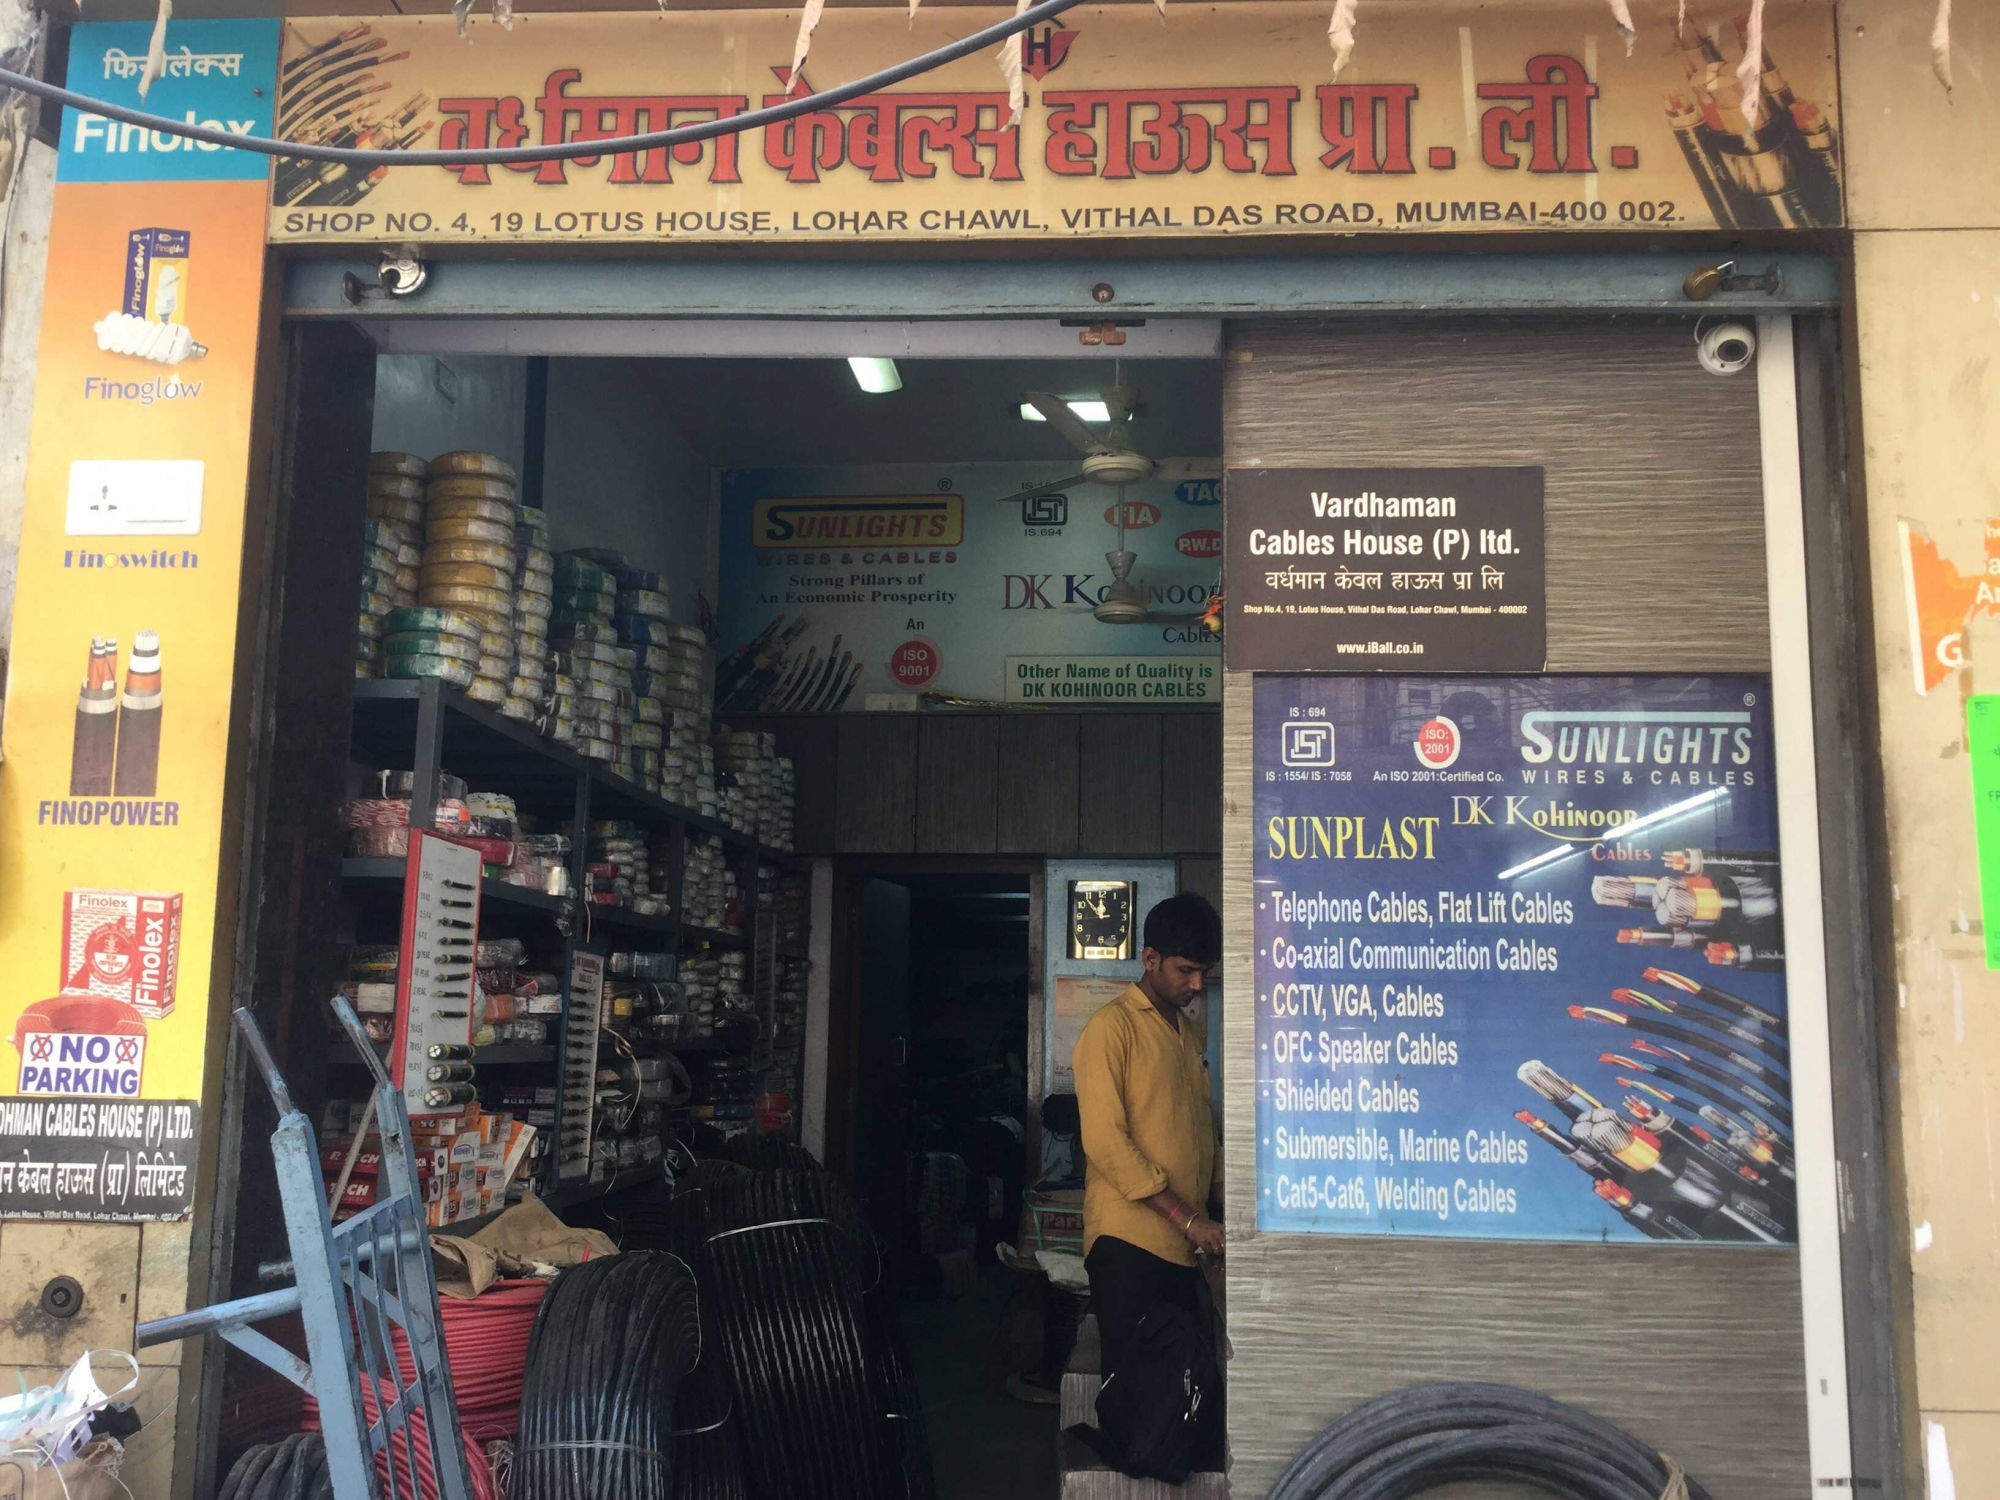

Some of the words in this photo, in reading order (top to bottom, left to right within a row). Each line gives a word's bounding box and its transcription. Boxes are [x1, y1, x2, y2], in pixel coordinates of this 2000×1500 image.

[75, 111, 255, 153] Finolex
[285, 213, 378, 232] SHOP
[386, 213, 440, 232] NO.
[452, 213, 478, 236] 4,
[491, 212, 522, 231] 19
[534, 212, 643, 232] LOTUS
[656, 212, 779, 234] HOUSE,
[792, 211, 907, 231] LOHAR
[919, 210, 1048, 232] CHAWL,
[1061, 208, 1181, 229] VITHAL
[1193, 206, 1262, 227] DAS
[1275, 204, 1385, 226] ROAD,
[1396, 203, 1607, 223] MUMBAI-400
[1619, 202, 1685, 222] 002.
[85, 377, 202, 405] Finoglow
[1311, 492, 1456, 518] Vardhaman
[766, 502, 947, 541] SUNLIGHTS
[1249, 529, 1335, 555] Cables
[1344, 529, 1423, 555] House
[1433, 528, 1470, 560] (P)
[1480, 528, 1520, 555] ltd.
[756, 553, 831, 565] WIRES
[841, 552, 853, 565] &
[862, 551, 957, 564] CABLES
[789, 574, 844, 589] Strong
[850, 573, 902, 586] Pillars
[908, 572, 925, 585] of
[1265, 565, 1326, 590] वर्धमान
[1391, 571, 1445, 591] हाऊस
[1453, 571, 1473, 591] प्रा
[1481, 565, 1505, 590] लि
[757, 591, 778, 604] An
[785, 591, 864, 603] Economic
[871, 590, 957, 605] Prosperity
[1002, 574, 1056, 610] DK
[1243, 604, 1263, 614] Shop
[1298, 605, 1319, 614] Lotus
[1320, 605, 1346, 614] House,
[1348, 605, 1369, 614] Vithal
[1371, 605, 1385, 614] Das
[1410, 605, 1432, 614] Lohar
[1461, 605, 1492, 614] Mumbai
[1499, 605, 1528, 614] 400002
[906, 618, 924, 630] An
[903, 650, 927, 661] ISO
[1337, 642, 1424, 654] www.iBall.co.in
[899, 664, 930, 677] 9001
[1017, 663, 1060, 678] Other
[1066, 663, 1110, 678] Name
[1115, 663, 1130, 678] of
[1137, 663, 1193, 680] Quality
[1199, 662, 1212, 677] is
[1023, 683, 1047, 697] DK
[1051, 682, 1136, 697] KOHINOOR
[1143, 682, 1206, 697] CABLES
[1308, 707, 1326, 717] 694
[1425, 743, 1450, 755] 2001
[1521, 711, 1752, 763] SUNLIGHTS
[1330, 771, 1352, 782] 7058
[1373, 771, 1387, 781] An
[1390, 771, 1409, 782] ISO
[1487, 771, 1504, 782] Co.
[1523, 770, 1605, 784] WIRES
[1622, 771, 1634, 784] &
[1651, 771, 1754, 786] CABLES
[38, 800, 180, 826] FINOPOWER
[1451, 796, 1494, 826] DK
[1268, 816, 1440, 860] SUNPLAST
[79, 895, 128, 908] Finolex
[1272, 891, 1362, 929] Telephone
[1368, 891, 1433, 928] Cables,
[1439, 891, 1472, 923] Flat
[1477, 891, 1506, 923] Lift
[1511, 892, 1574, 924] Cables
[135, 917, 164, 1005] Finolex
[1272, 937, 1344, 969] Co-axial
[1349, 937, 1490, 970] Communication
[1496, 938, 1558, 971] Cables
[1273, 983, 1326, 1020] CCTV,
[1331, 984, 1377, 1021] VGA,
[1382, 984, 1444, 1017] Cables
[59, 1036, 110, 1063] NO
[1274, 1031, 1312, 1063] OFC
[1318, 1031, 1391, 1071] Speaker
[1396, 1032, 1458, 1065] Cables
[22, 1067, 138, 1094] PARKING
[1275, 1078, 1353, 1111] Shielded
[1358, 1080, 1419, 1112] Cables
[46, 1103, 96, 1137] CABLES
[98, 1105, 144, 1138] HOUSE
[145, 1105, 164, 1147] (P)
[1276, 1127, 1393, 1166] Submersible,
[1400, 1128, 1460, 1162] Marine
[1466, 1130, 1528, 1163] Cables
[1277, 1175, 1370, 1214] Cat5-Cat6,
[1375, 1178, 1449, 1220] Welding
[1454, 1179, 1517, 1213] Cables
